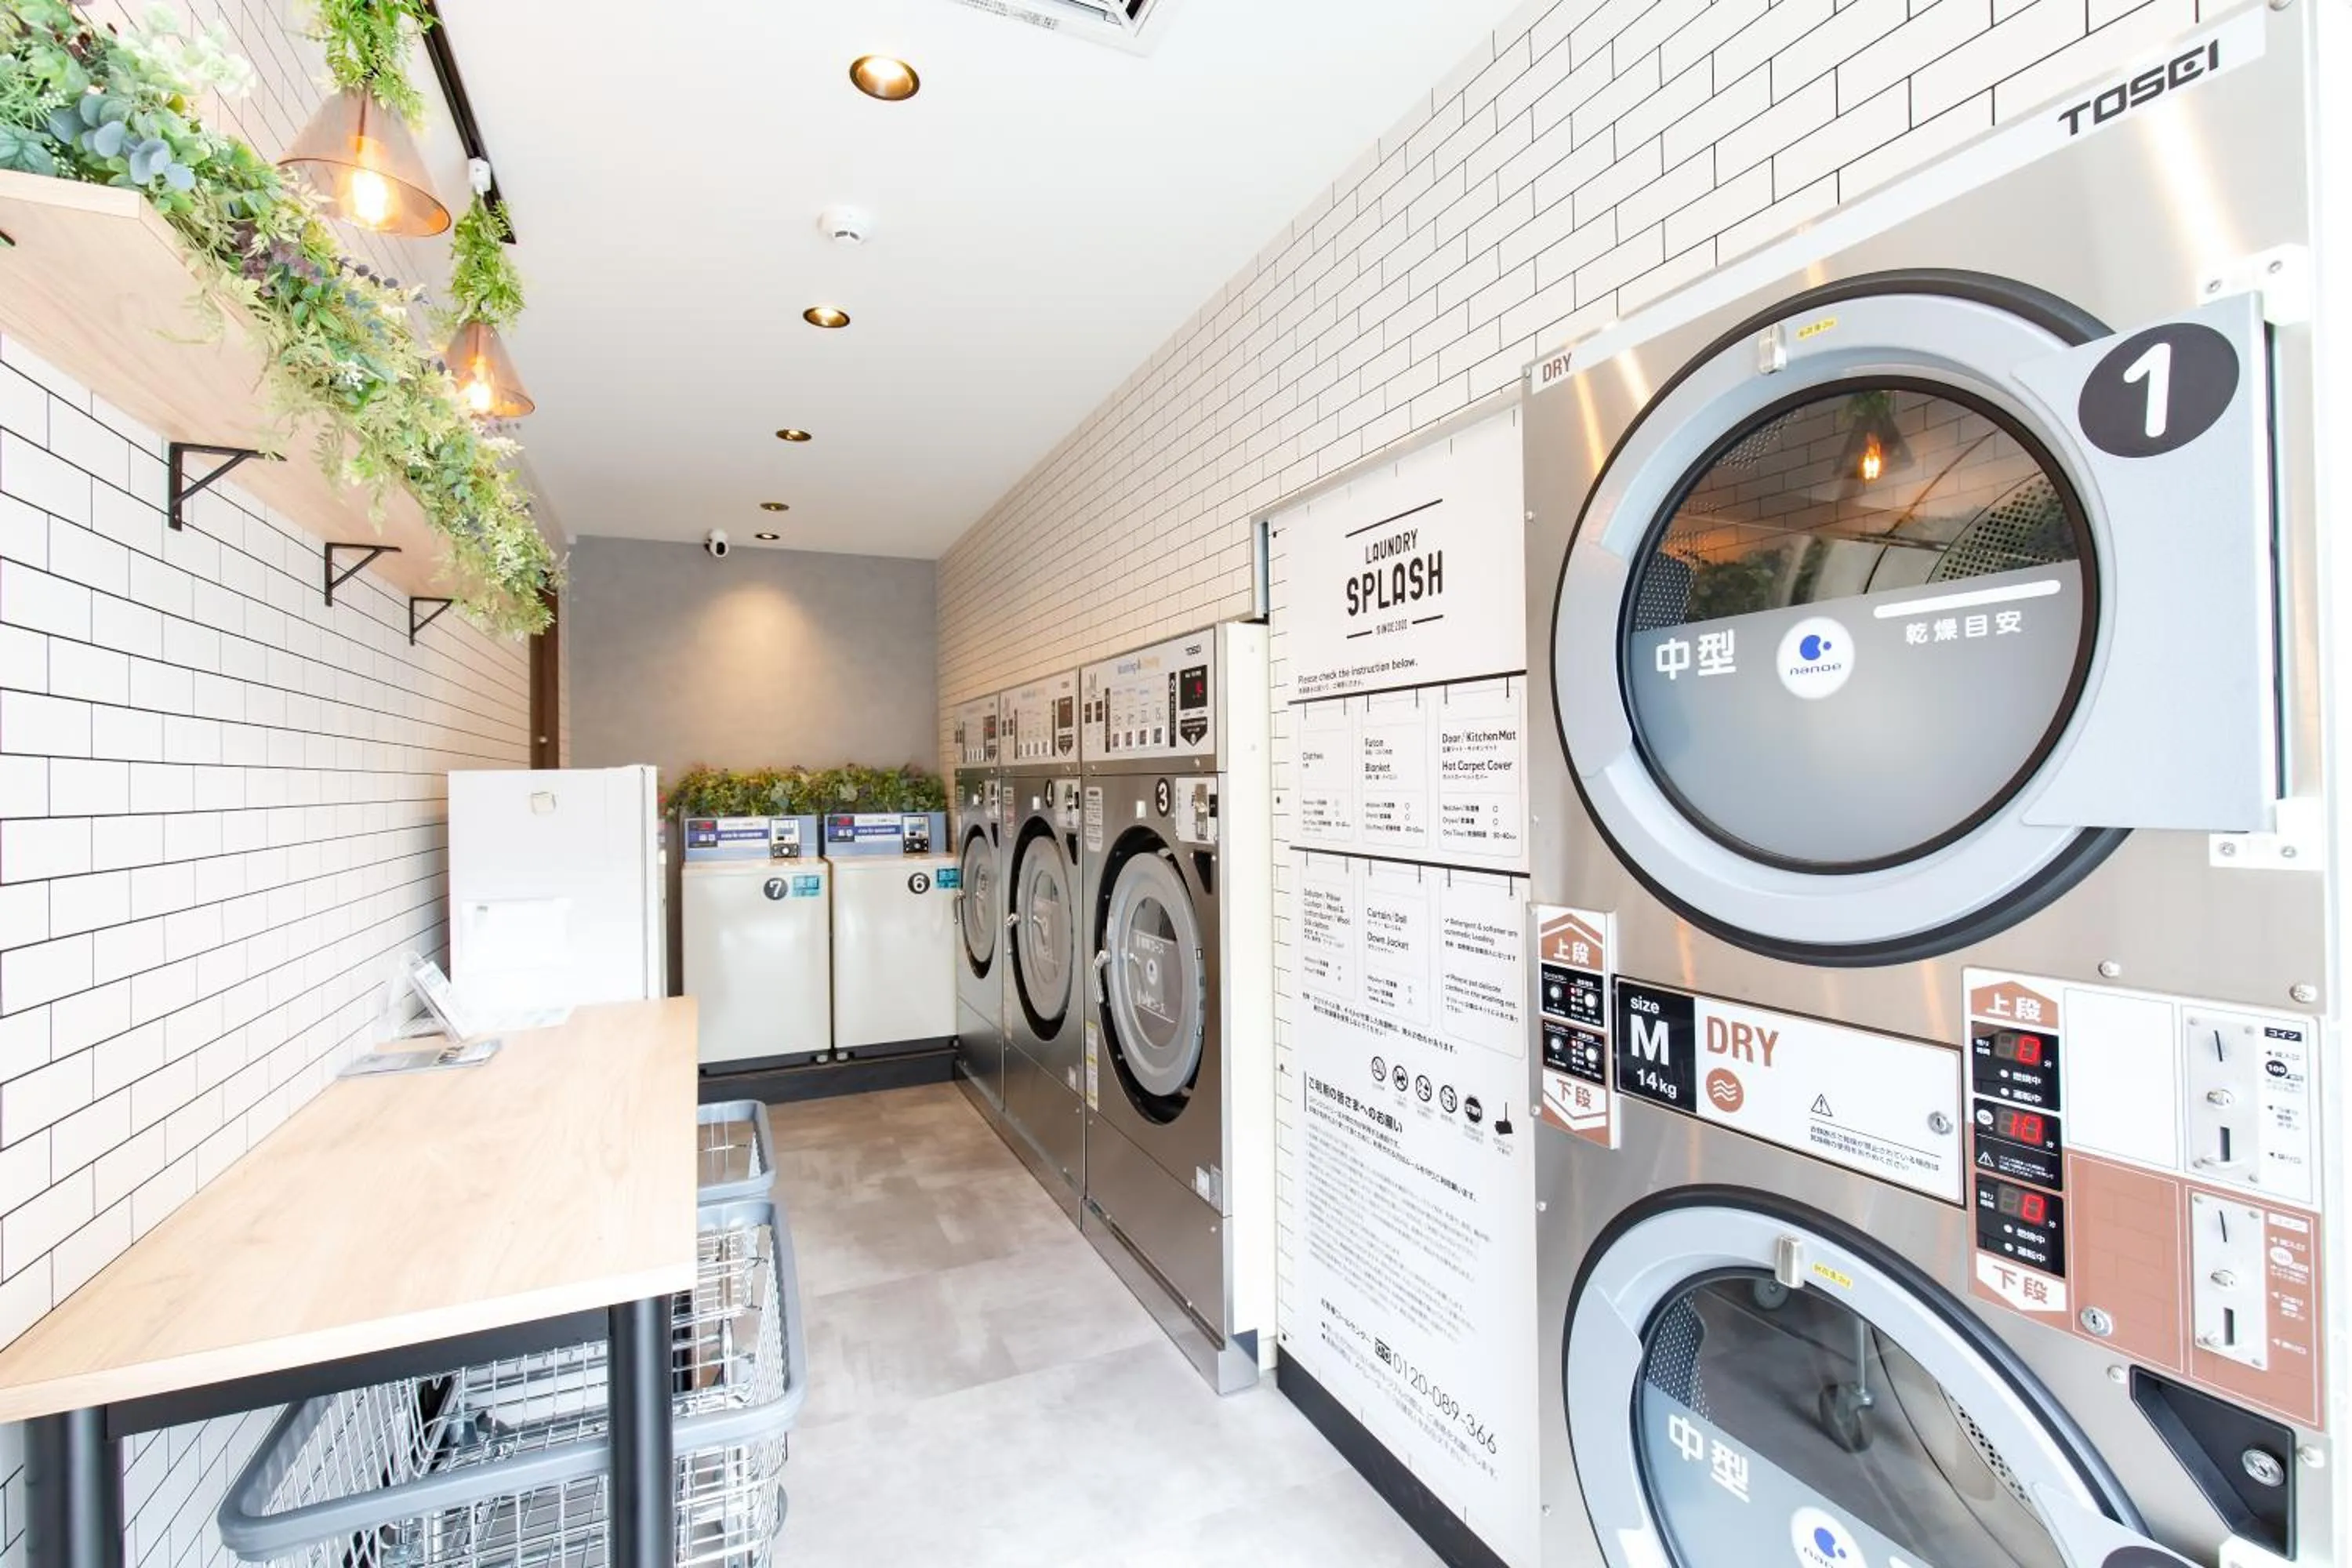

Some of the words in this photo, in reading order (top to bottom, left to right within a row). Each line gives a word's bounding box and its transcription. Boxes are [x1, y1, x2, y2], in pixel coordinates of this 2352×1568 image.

[2057, 38, 2220, 136] TOSEI
[1543, 351, 1572, 383] DRY
[2123, 343, 2172, 438] 1
[1365, 528, 1418, 565] LAUNDRY
[1345, 550, 1443, 617] SPLASH
[1905, 611, 2023, 645] 乾燥目安
[1298, 675, 1319, 684] Please
[1319, 672, 1337, 681] check
[1338, 669, 1349, 678] the
[1351, 662, 1390, 677] instruction
[1392, 657, 1418, 670] below.
[1655, 629, 1737, 681] 中型
[1457, 760, 1485, 773] Carpet
[1487, 760, 1512, 771] Cover
[1158, 782, 1168, 812] 3
[769, 880, 782, 898] 7
[913, 873, 926, 891] 6
[1553, 938, 1590, 964] 上段
[1630, 995, 1660, 1014] size
[1985, 992, 2042, 1022] 上段
[1630, 1014, 1669, 1066] M
[1707, 1015, 1779, 1067] DRY
[2267, 1029, 2298, 1039] コイン
[1636, 1068, 1677, 1099] 14kg
[2267, 1064, 2285, 1073] 100
[1556, 1078, 1592, 1110] 下段
[1992, 1265, 2049, 1305] 下段
[1392, 1352, 1497, 1455] 0120-089-366
[1668, 1414, 1750, 1504] 中型
